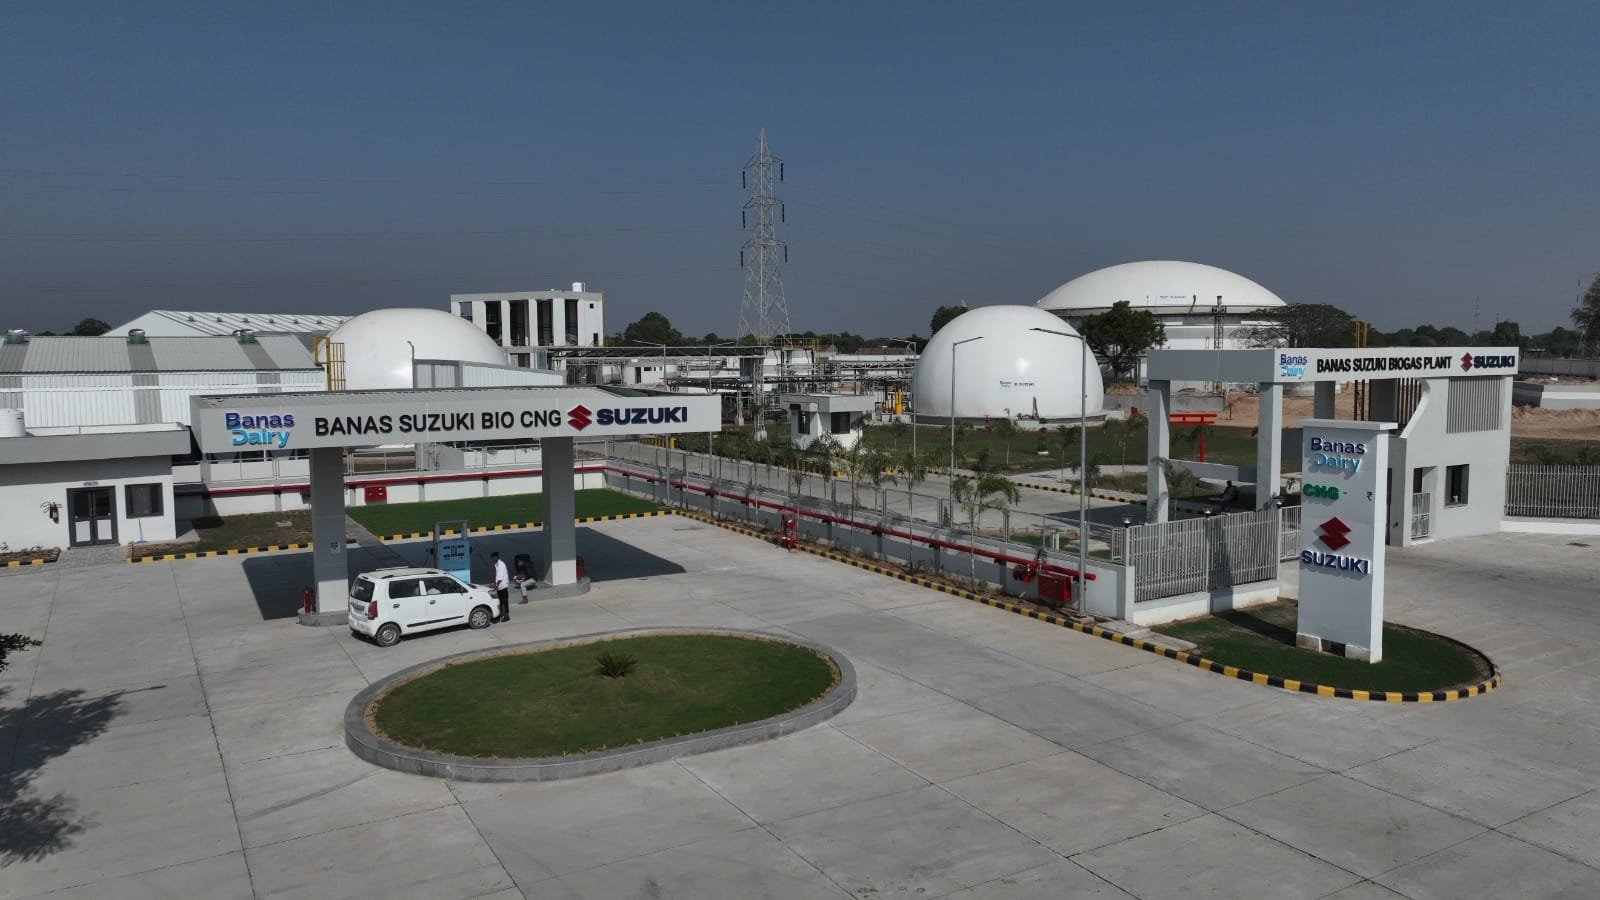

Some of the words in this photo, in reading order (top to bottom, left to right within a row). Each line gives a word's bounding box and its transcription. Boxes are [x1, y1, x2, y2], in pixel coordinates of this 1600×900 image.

[1280, 354, 1308, 365] Banas
[1316, 359, 1352, 373] BANAS
[1353, 357, 1387, 372] SUZUKI
[1388, 357, 1423, 371] BIOGAS
[1424, 356, 1453, 370] PLANT
[1473, 355, 1515, 369] SUZUKI
[1281, 365, 1305, 379] Dairy
[225, 412, 295, 429] Banas
[315, 415, 393, 436] BANAS
[399, 412, 475, 433] SUZUKI
[481, 410, 515, 430] BIO
[520, 409, 562, 428] CNG
[596, 406, 688, 426] SUZUKI
[231, 429, 290, 448] Dairy
[1311, 437, 1366, 454] Banas
[1313, 453, 1362, 475] Dairy
[1303, 483, 1340, 501] CNG
[1300, 549, 1370, 575] SUZUKI
